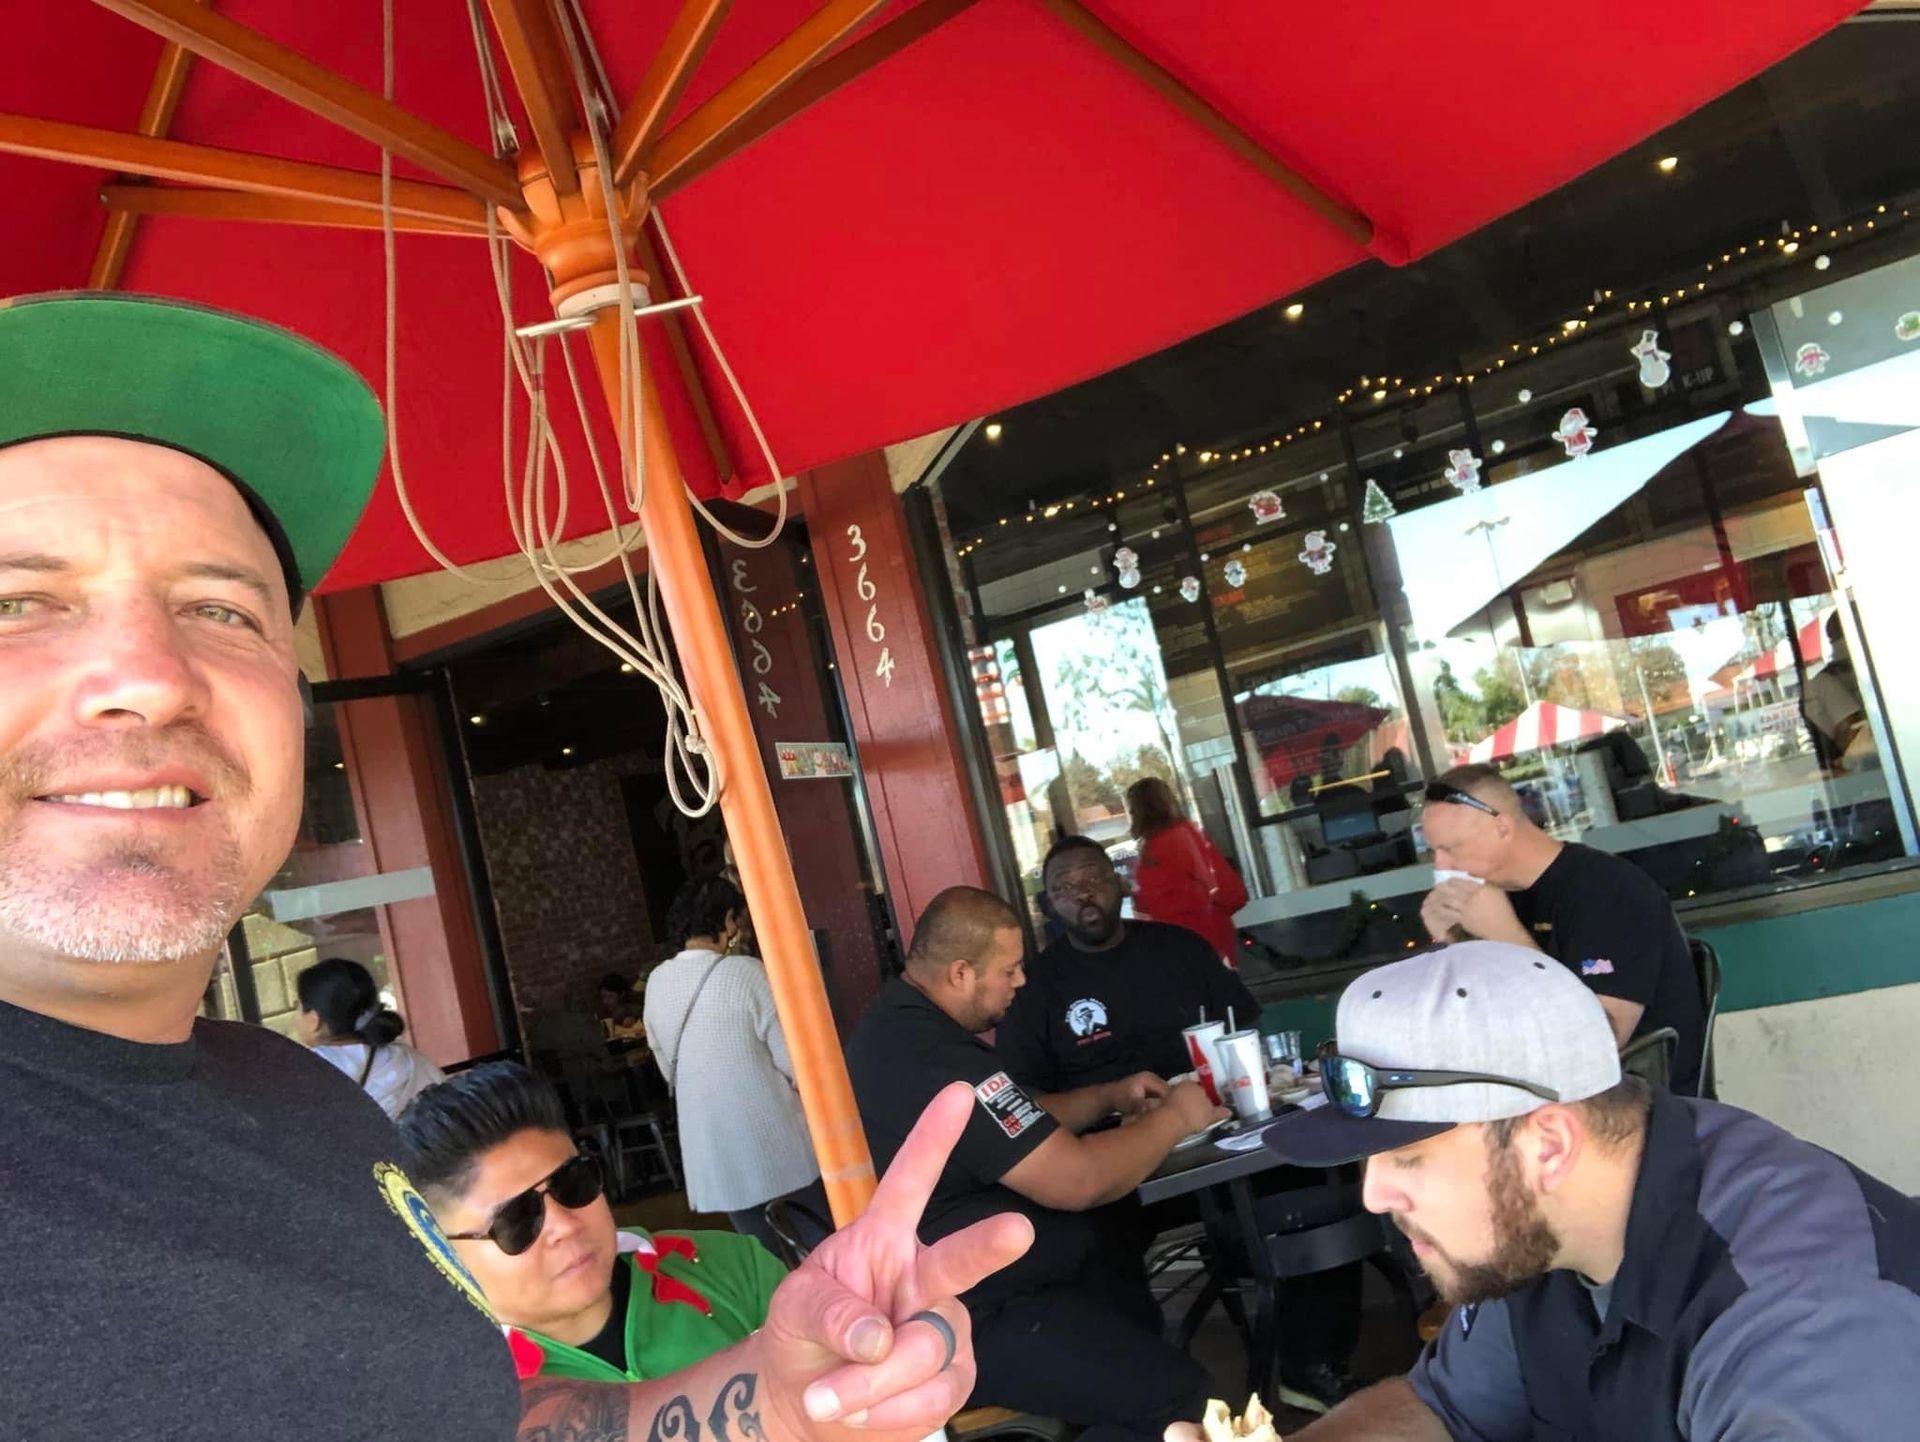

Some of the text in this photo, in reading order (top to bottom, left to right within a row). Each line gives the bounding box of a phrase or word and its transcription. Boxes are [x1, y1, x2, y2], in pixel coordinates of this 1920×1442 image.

[1661, 366, 1714, 396] PIK-UP
[847, 524, 895, 688] 3664
[980, 1075, 1009, 1098] IDA
